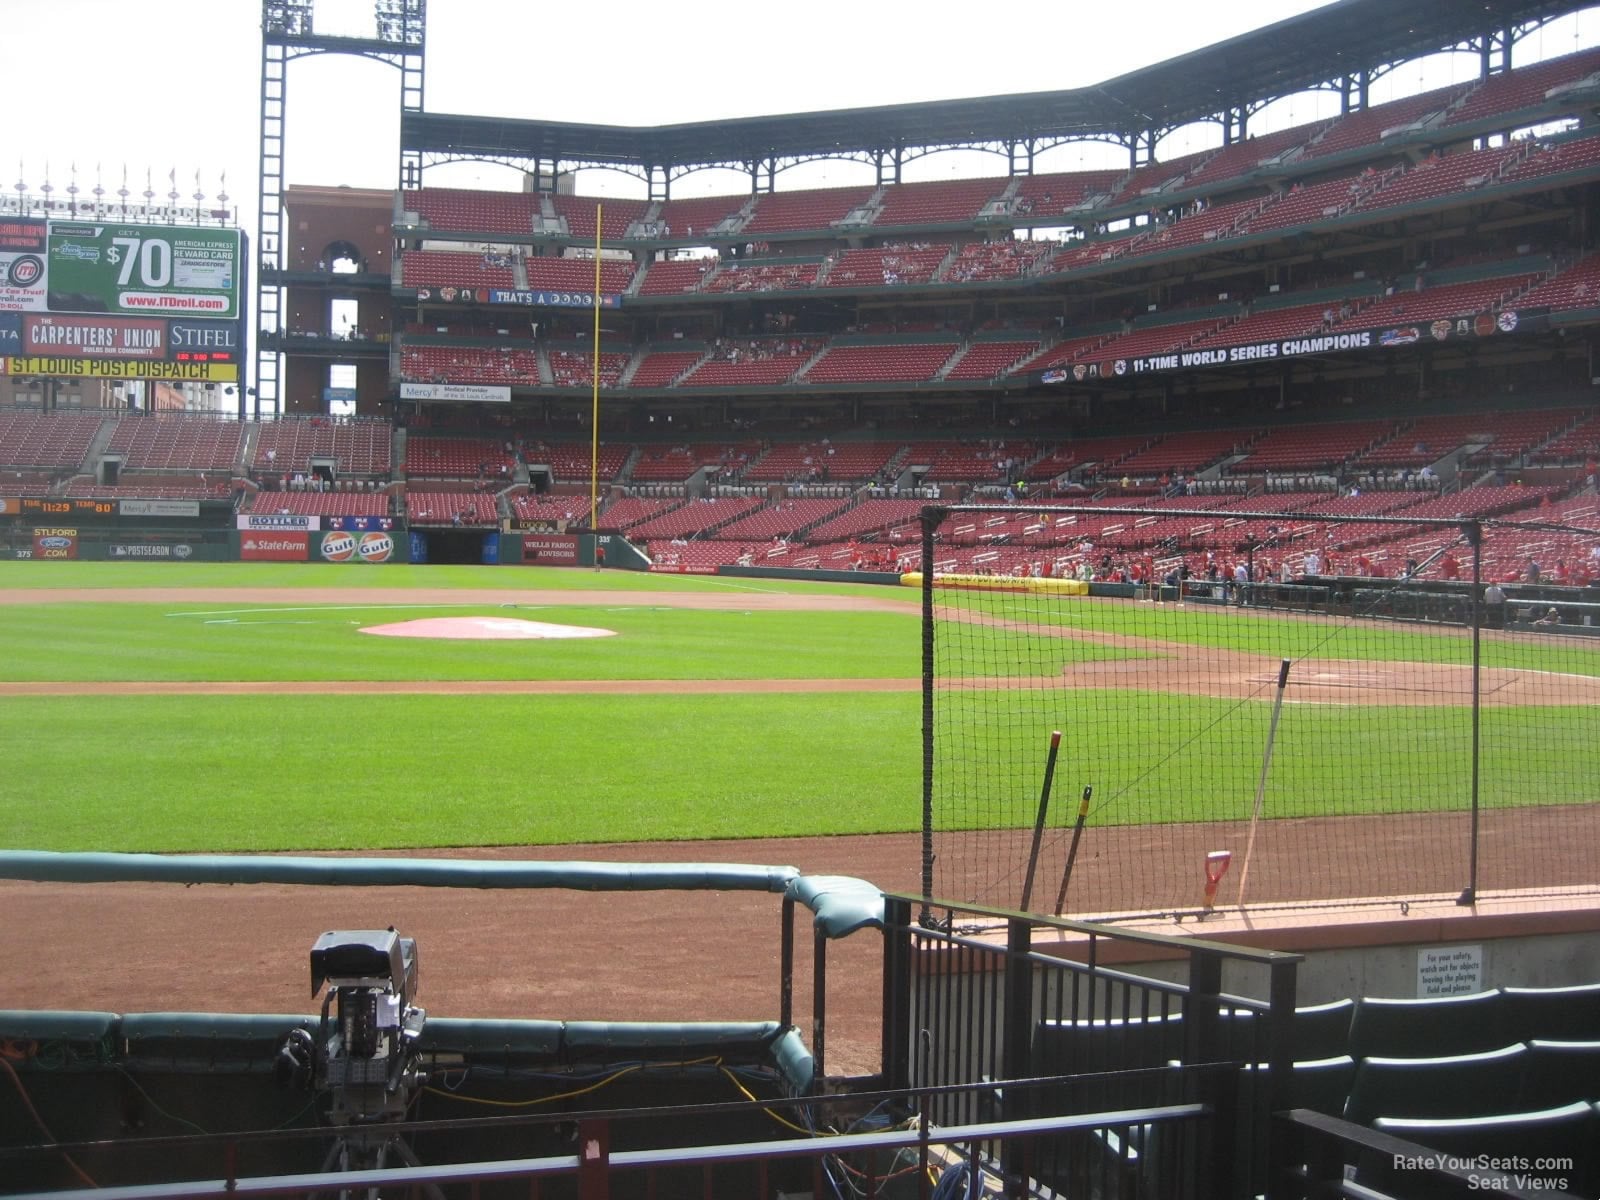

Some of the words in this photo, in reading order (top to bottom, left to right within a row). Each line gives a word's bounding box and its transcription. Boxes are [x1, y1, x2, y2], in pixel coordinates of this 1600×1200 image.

[75, 200, 213, 219] CHAMPIONS
[174, 240, 205, 248] AMERICAN
[207, 241, 233, 249] EXPRESS
[173, 250, 209, 259] REWARD
[211, 251, 234, 260] CARD
[125, 296, 223, 309] www.ITDroll.com
[496, 291, 533, 304] THAT'S
[537, 293, 545, 304] A
[31, 325, 118, 346] CARPENTERS'
[123, 329, 160, 348] UNION
[118, 347, 153, 355] COMMUNITY
[1133, 355, 1178, 371] 11-TIME
[1182, 349, 1226, 367] WORLD
[1230, 343, 1278, 361] SERIES
[1282, 332, 1370, 355] CHAMPIONS
[13, 357, 35, 373] ST.
[38, 358, 83, 375] LOUIS
[90, 360, 210, 378] POST-DISPATCH
[406, 387, 432, 398] Mercy
[42, 503, 70, 512] 11:29
[251, 516, 307, 525] ROTTLER
[34, 528, 77, 536] STLFORD
[128, 545, 170, 556] POSTSEASON
[323, 539, 354, 554] Gulf
[360, 541, 390, 554] Gulf
[525, 541, 549, 549] WELLS
[538, 550, 575, 558] ADVISORS
[1439, 954, 1451, 963] your
[1420, 965, 1437, 973] watch
[1439, 964, 1448, 972] out
[1450, 963, 1458, 971] for
[1460, 962, 1479, 971] objects
[1422, 975, 1443, 984] leaving
[1456, 973, 1476, 983] playing
[1441, 984, 1452, 993] and
[1453, 985, 1471, 993] please
